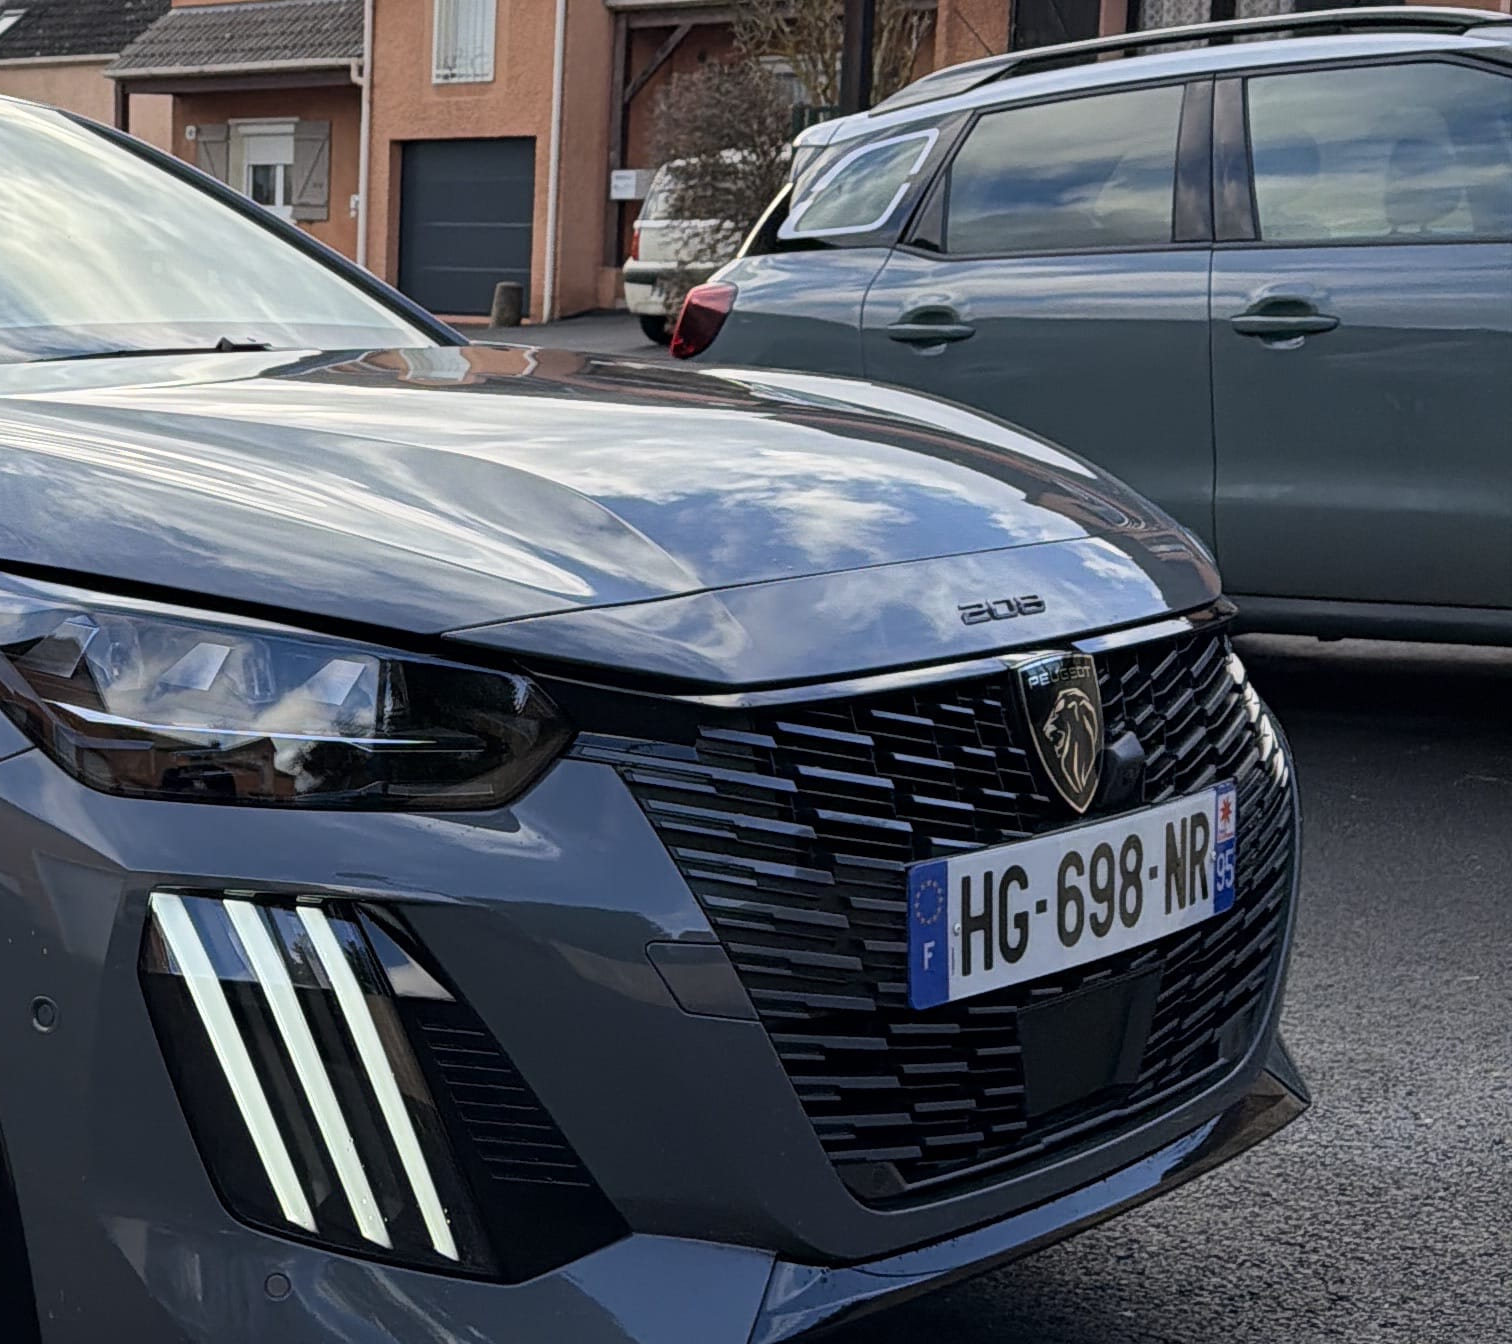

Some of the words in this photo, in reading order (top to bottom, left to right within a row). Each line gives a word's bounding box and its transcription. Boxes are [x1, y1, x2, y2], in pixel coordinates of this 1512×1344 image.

[957, 594, 1046, 626] 208
[1028, 665, 1091, 689] PEUGEOT
[1216, 848, 1235, 892] 95
[961, 812, 1210, 977] HG-698-NR
[923, 940, 936, 971] F
